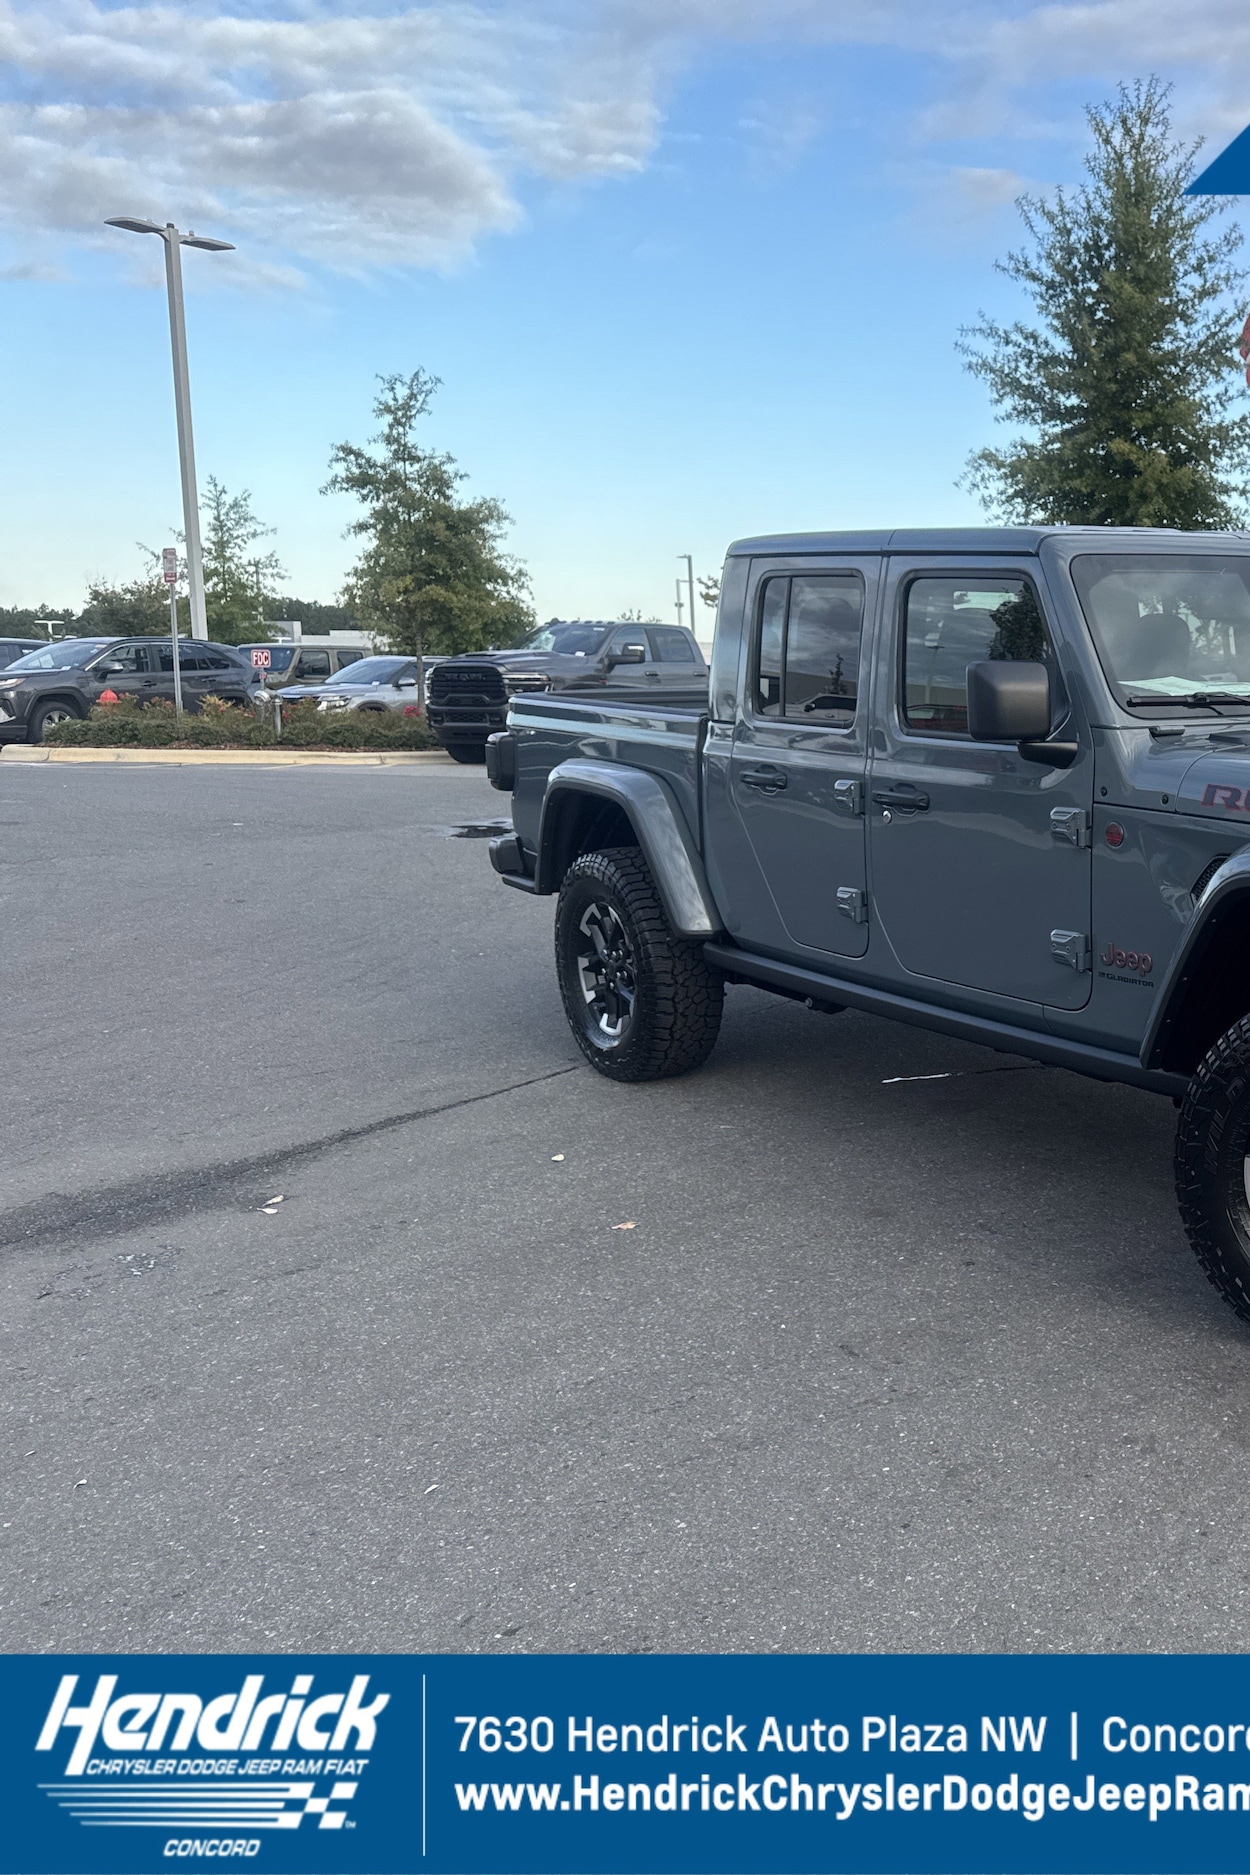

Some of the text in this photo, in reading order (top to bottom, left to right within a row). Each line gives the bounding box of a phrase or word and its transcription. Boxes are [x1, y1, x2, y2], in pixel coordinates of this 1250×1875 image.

[252, 651, 269, 665] FDC
[1100, 942, 1153, 977] Jeep
[1106, 973, 1154, 988] GLADIATOR
